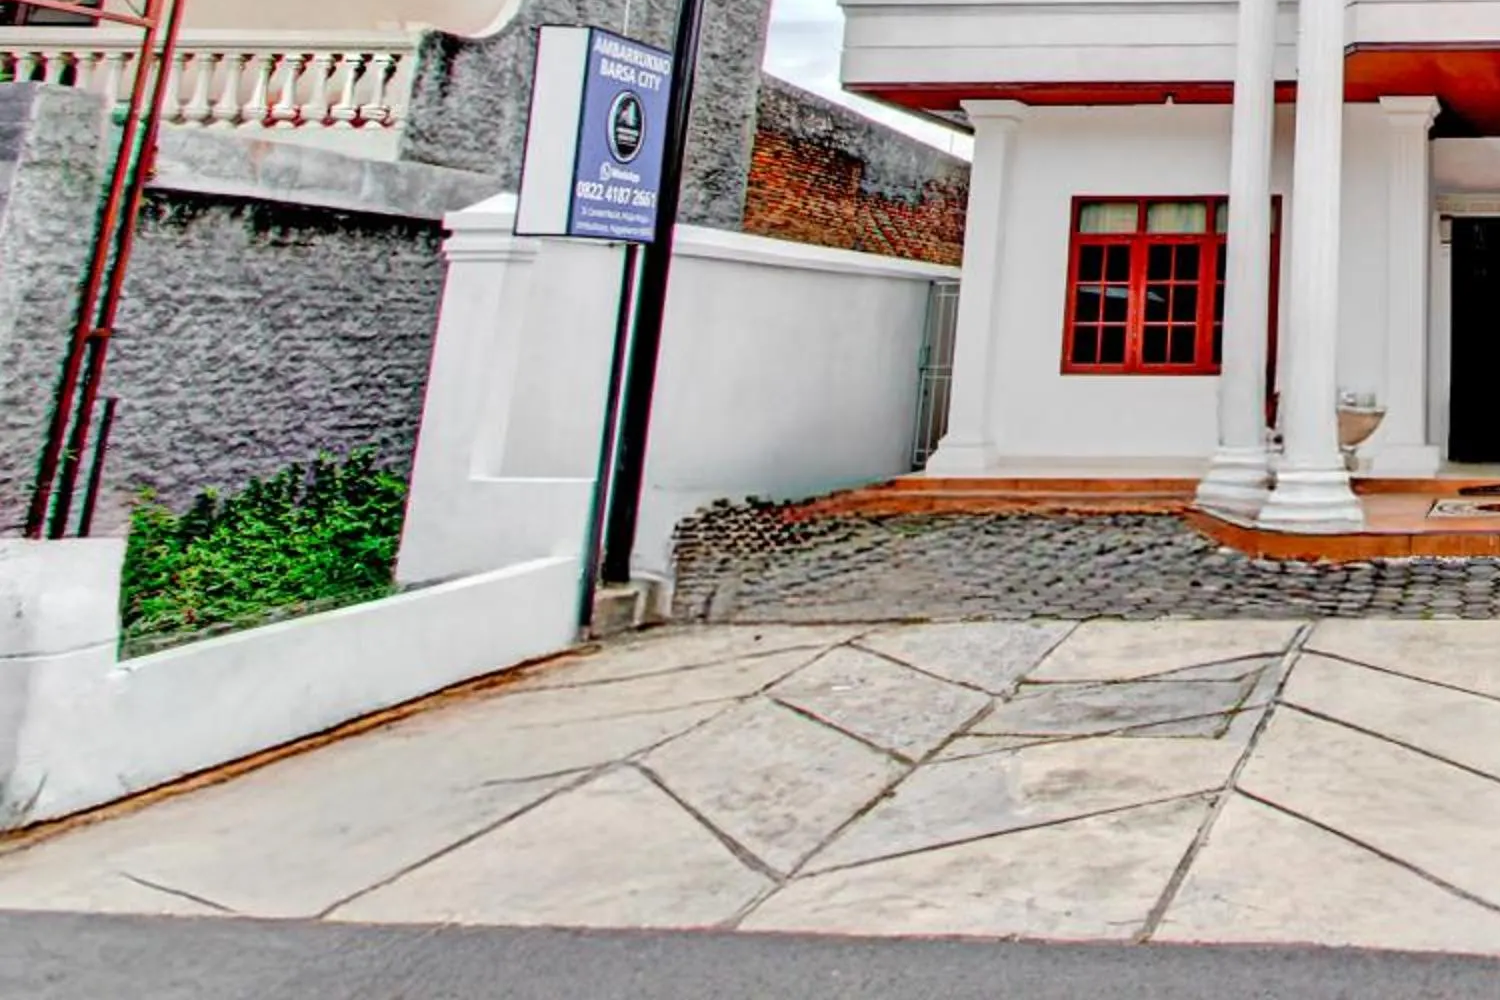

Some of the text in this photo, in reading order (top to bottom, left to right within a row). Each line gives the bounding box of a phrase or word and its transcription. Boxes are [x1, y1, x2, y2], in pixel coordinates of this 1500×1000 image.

[600, 58, 662, 91] BARSA CITY
[576, 180, 603, 199] 0822
